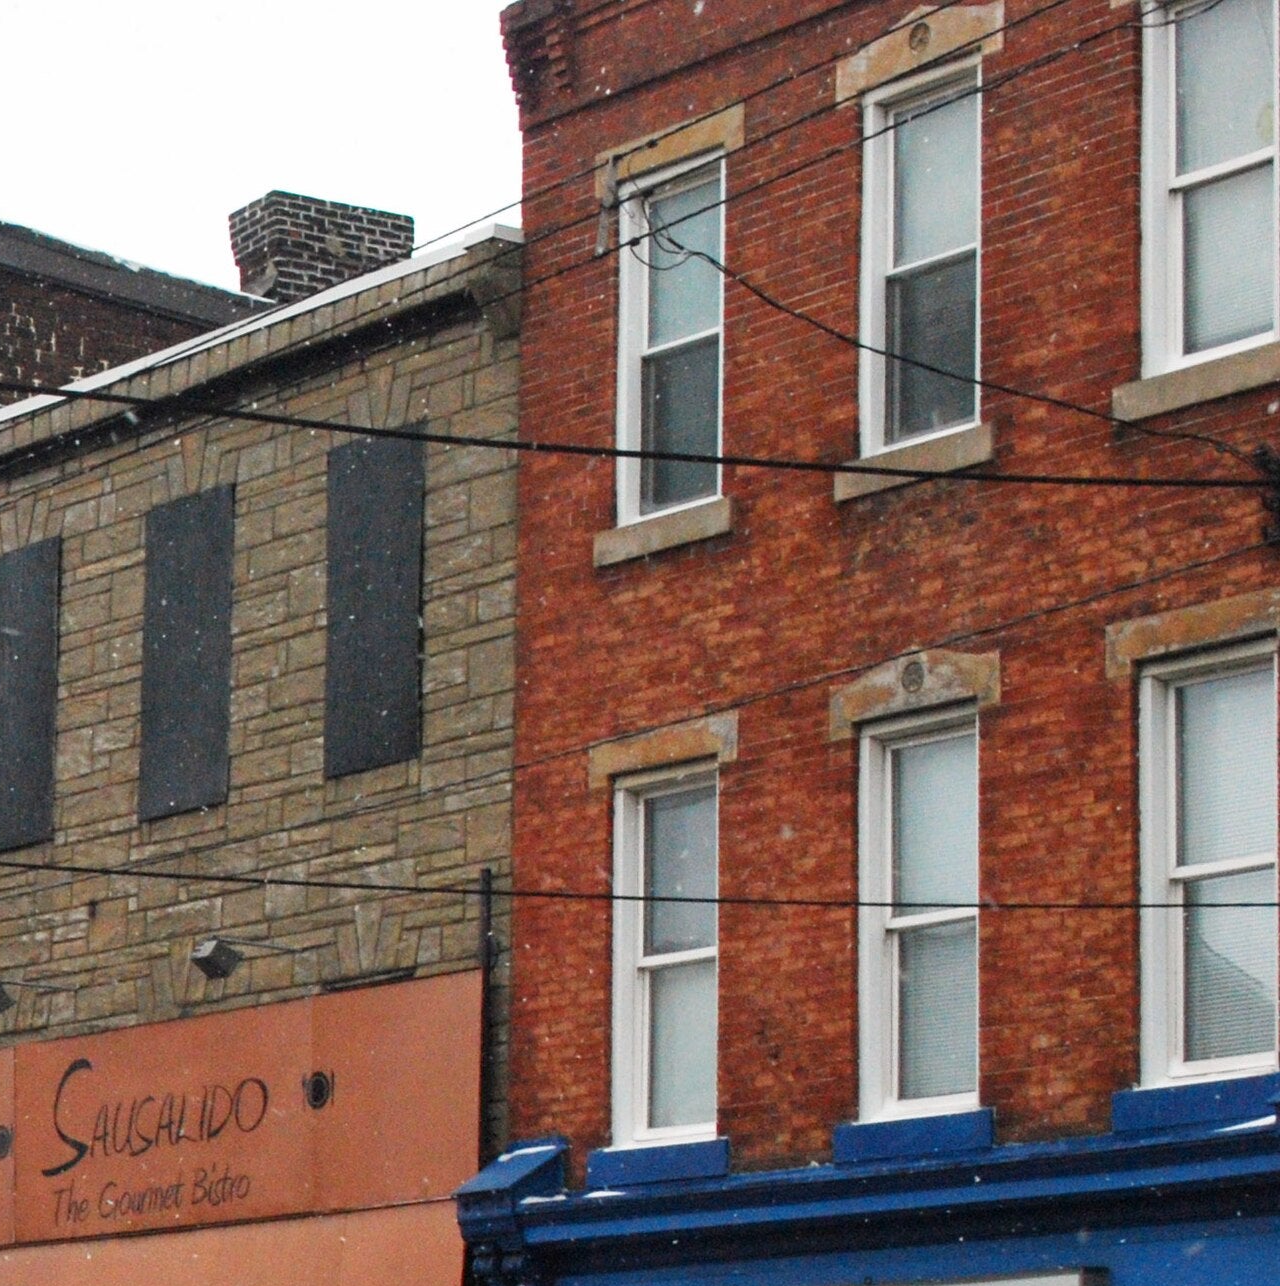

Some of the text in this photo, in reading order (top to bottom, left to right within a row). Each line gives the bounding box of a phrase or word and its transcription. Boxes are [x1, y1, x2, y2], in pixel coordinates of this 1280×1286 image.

[54, 1163, 251, 1227] The Gourmet Bistro
